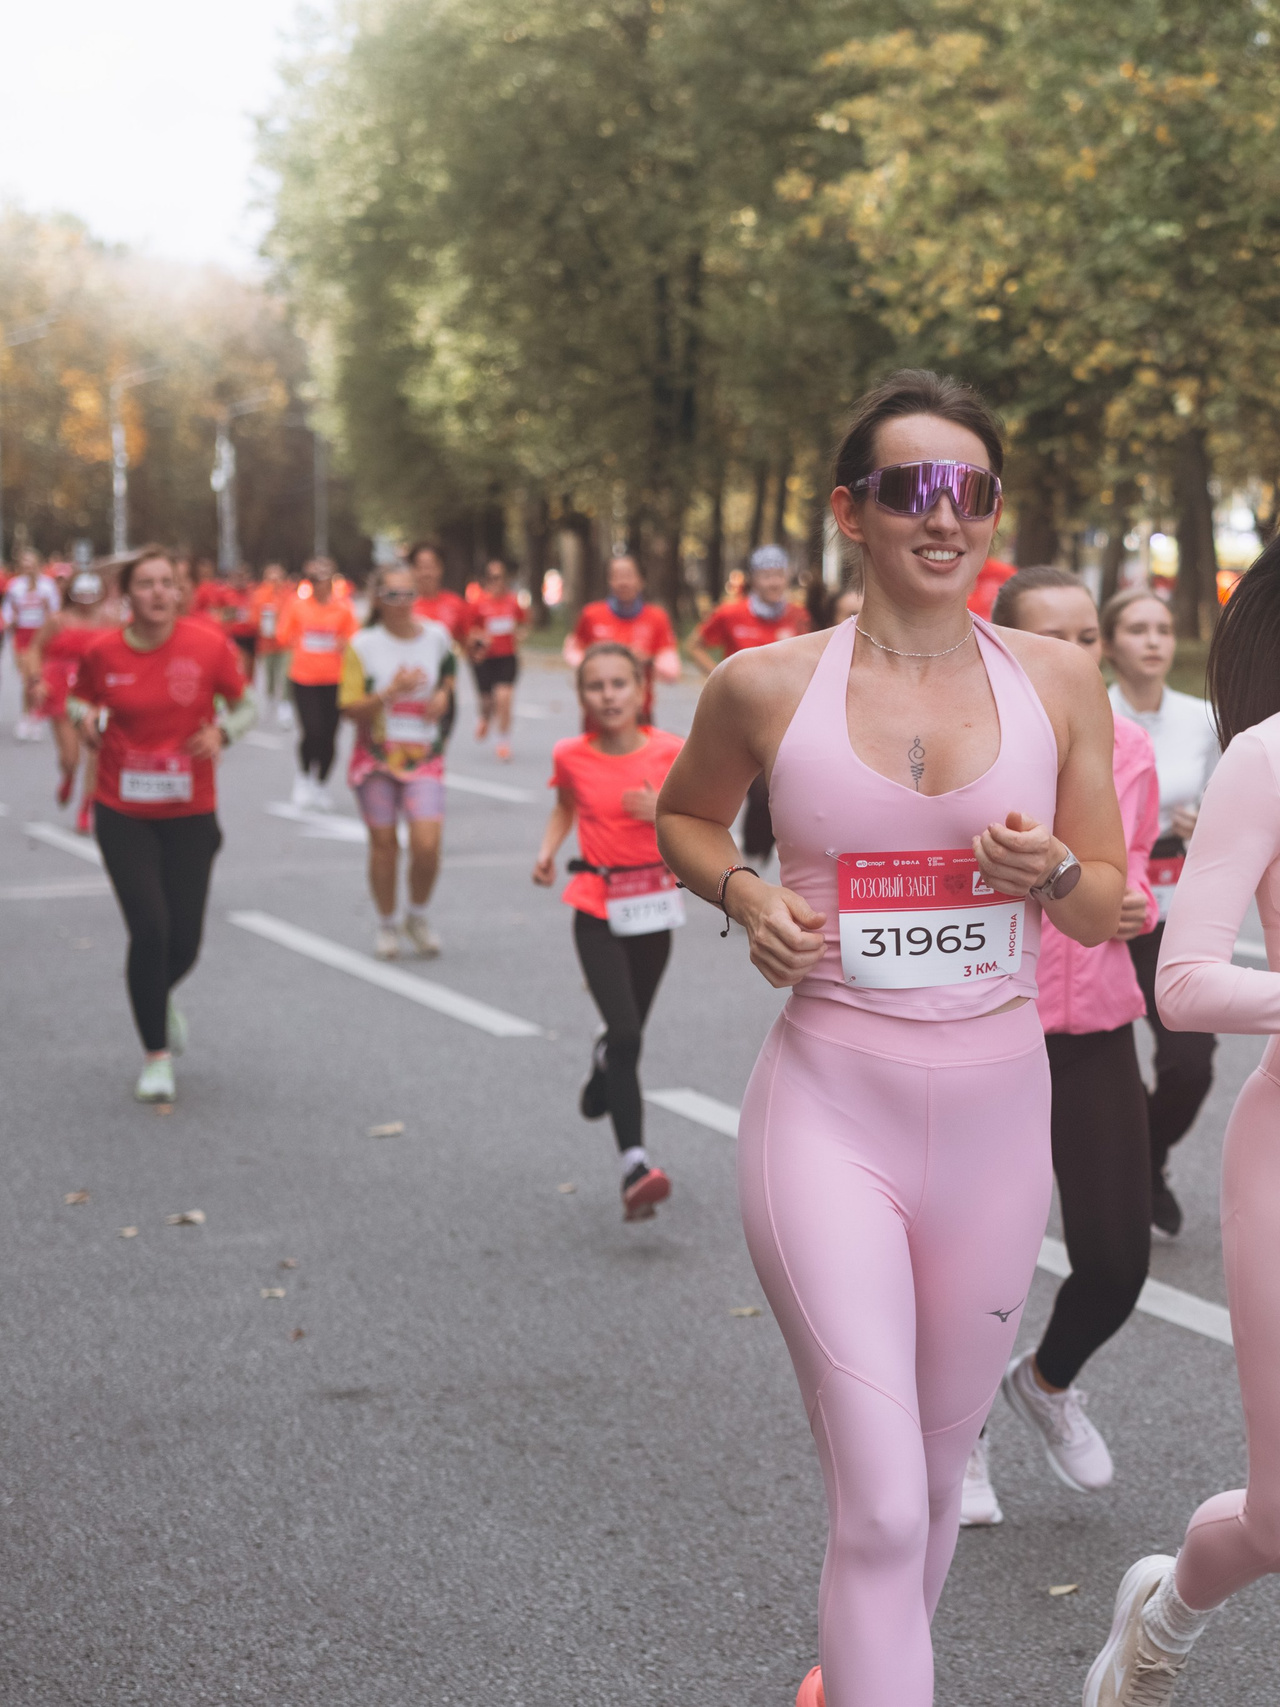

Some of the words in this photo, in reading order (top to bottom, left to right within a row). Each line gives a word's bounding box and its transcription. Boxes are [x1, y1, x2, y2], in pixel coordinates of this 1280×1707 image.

[850, 873, 904, 899] РОЗОВЫЙ
[905, 875, 938, 897] ЗАБЕГ
[861, 922, 986, 957] 31965
[1008, 913, 1018, 957] МОСКВА
[963, 965, 972, 977] 3
